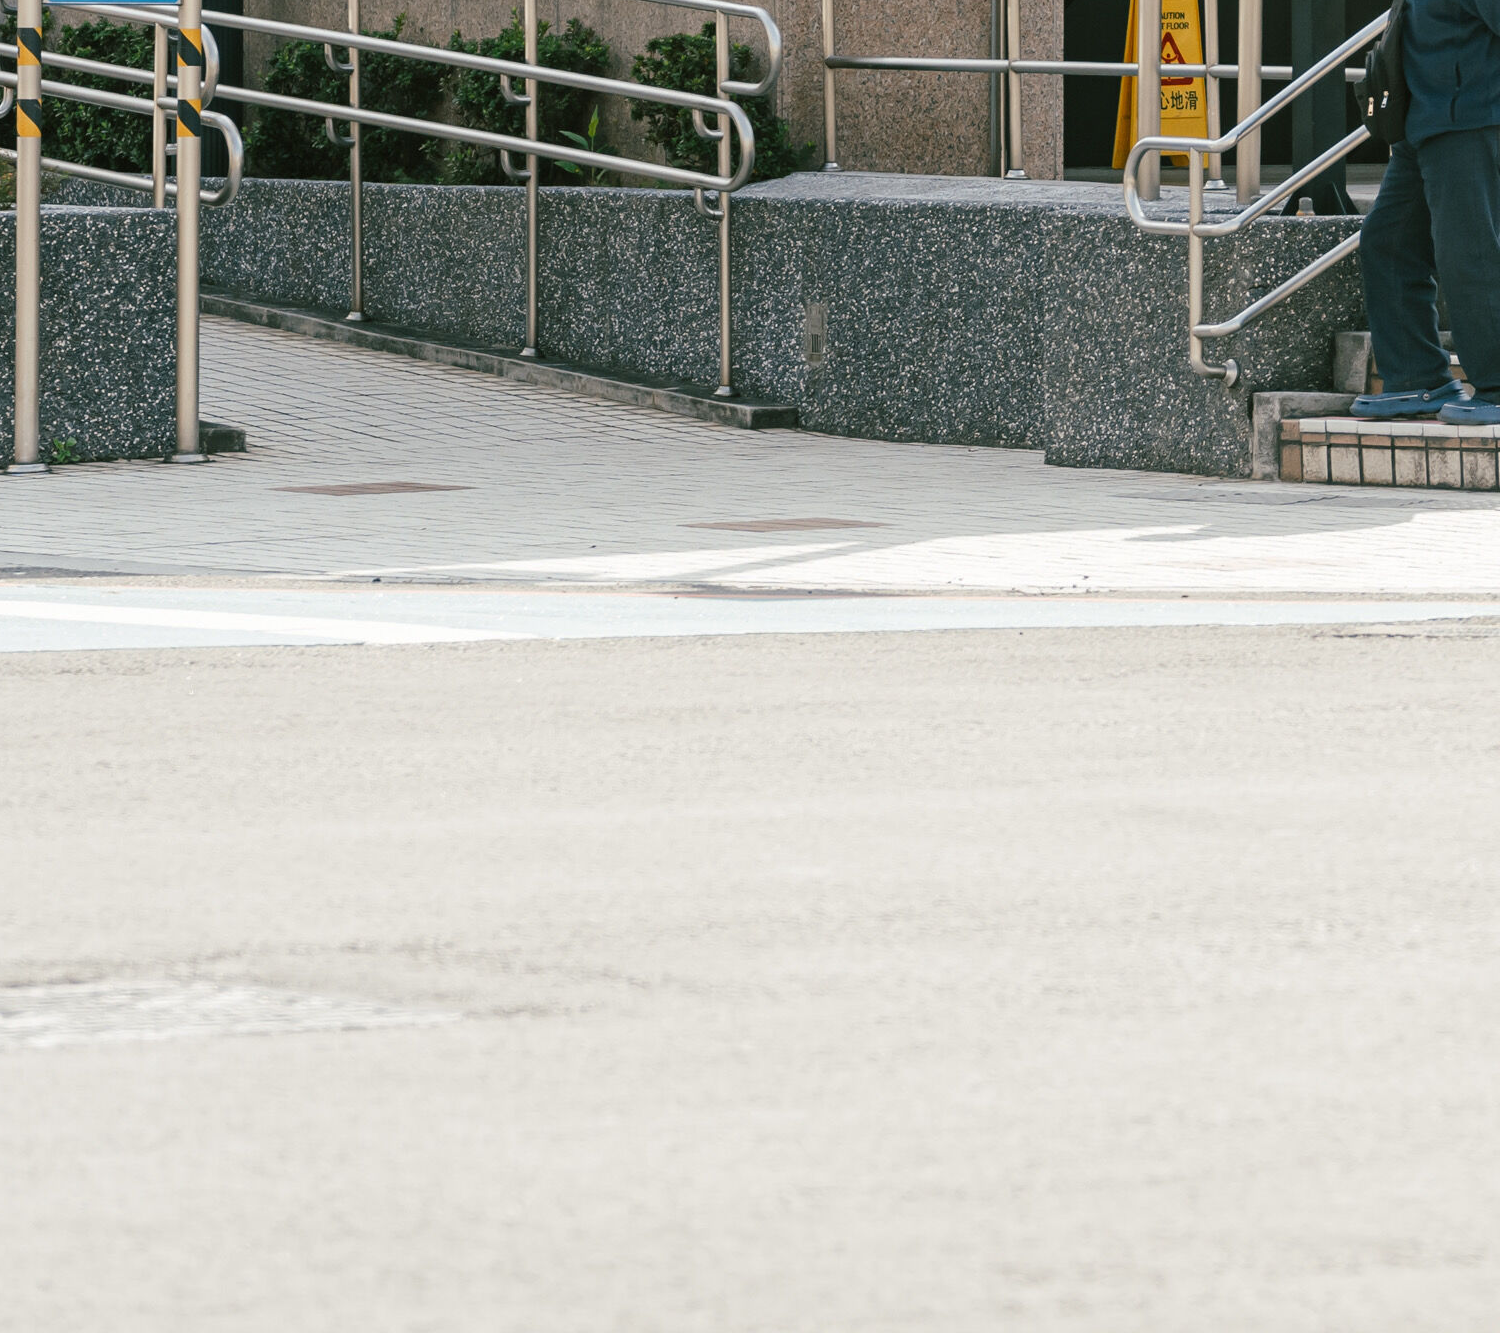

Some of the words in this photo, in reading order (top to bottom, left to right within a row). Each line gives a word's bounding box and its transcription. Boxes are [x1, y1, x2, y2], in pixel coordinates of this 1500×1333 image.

[1166, 21, 1190, 30] FLOOR
[1160, 90, 1199, 111] 心地滑
